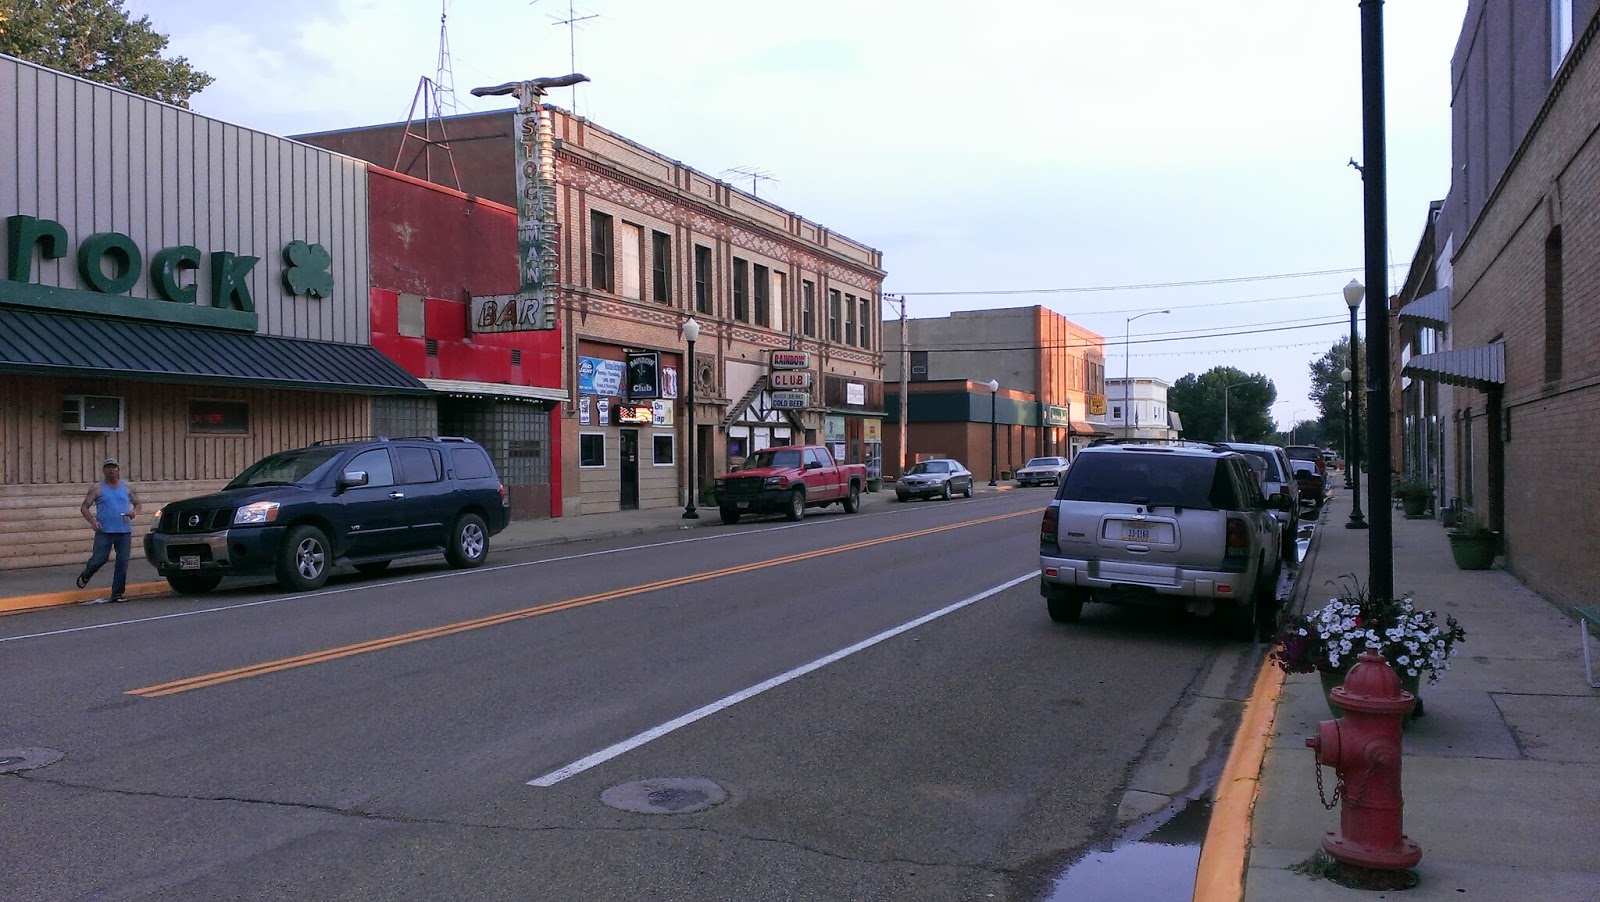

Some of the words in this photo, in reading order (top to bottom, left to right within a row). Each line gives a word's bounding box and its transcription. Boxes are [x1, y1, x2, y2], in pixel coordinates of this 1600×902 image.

[521, 117, 540, 284] STOCKMAN
[478, 299, 539, 327] BAR
[629, 357, 655, 368] RAINBOW
[774, 354, 806, 366] RAINBOW
[775, 375, 803, 385] CLUB
[633, 384, 652, 392] Club
[654, 402, 663, 410] On
[789, 400, 804, 408] BEER
[654, 413, 665, 423] Tap
